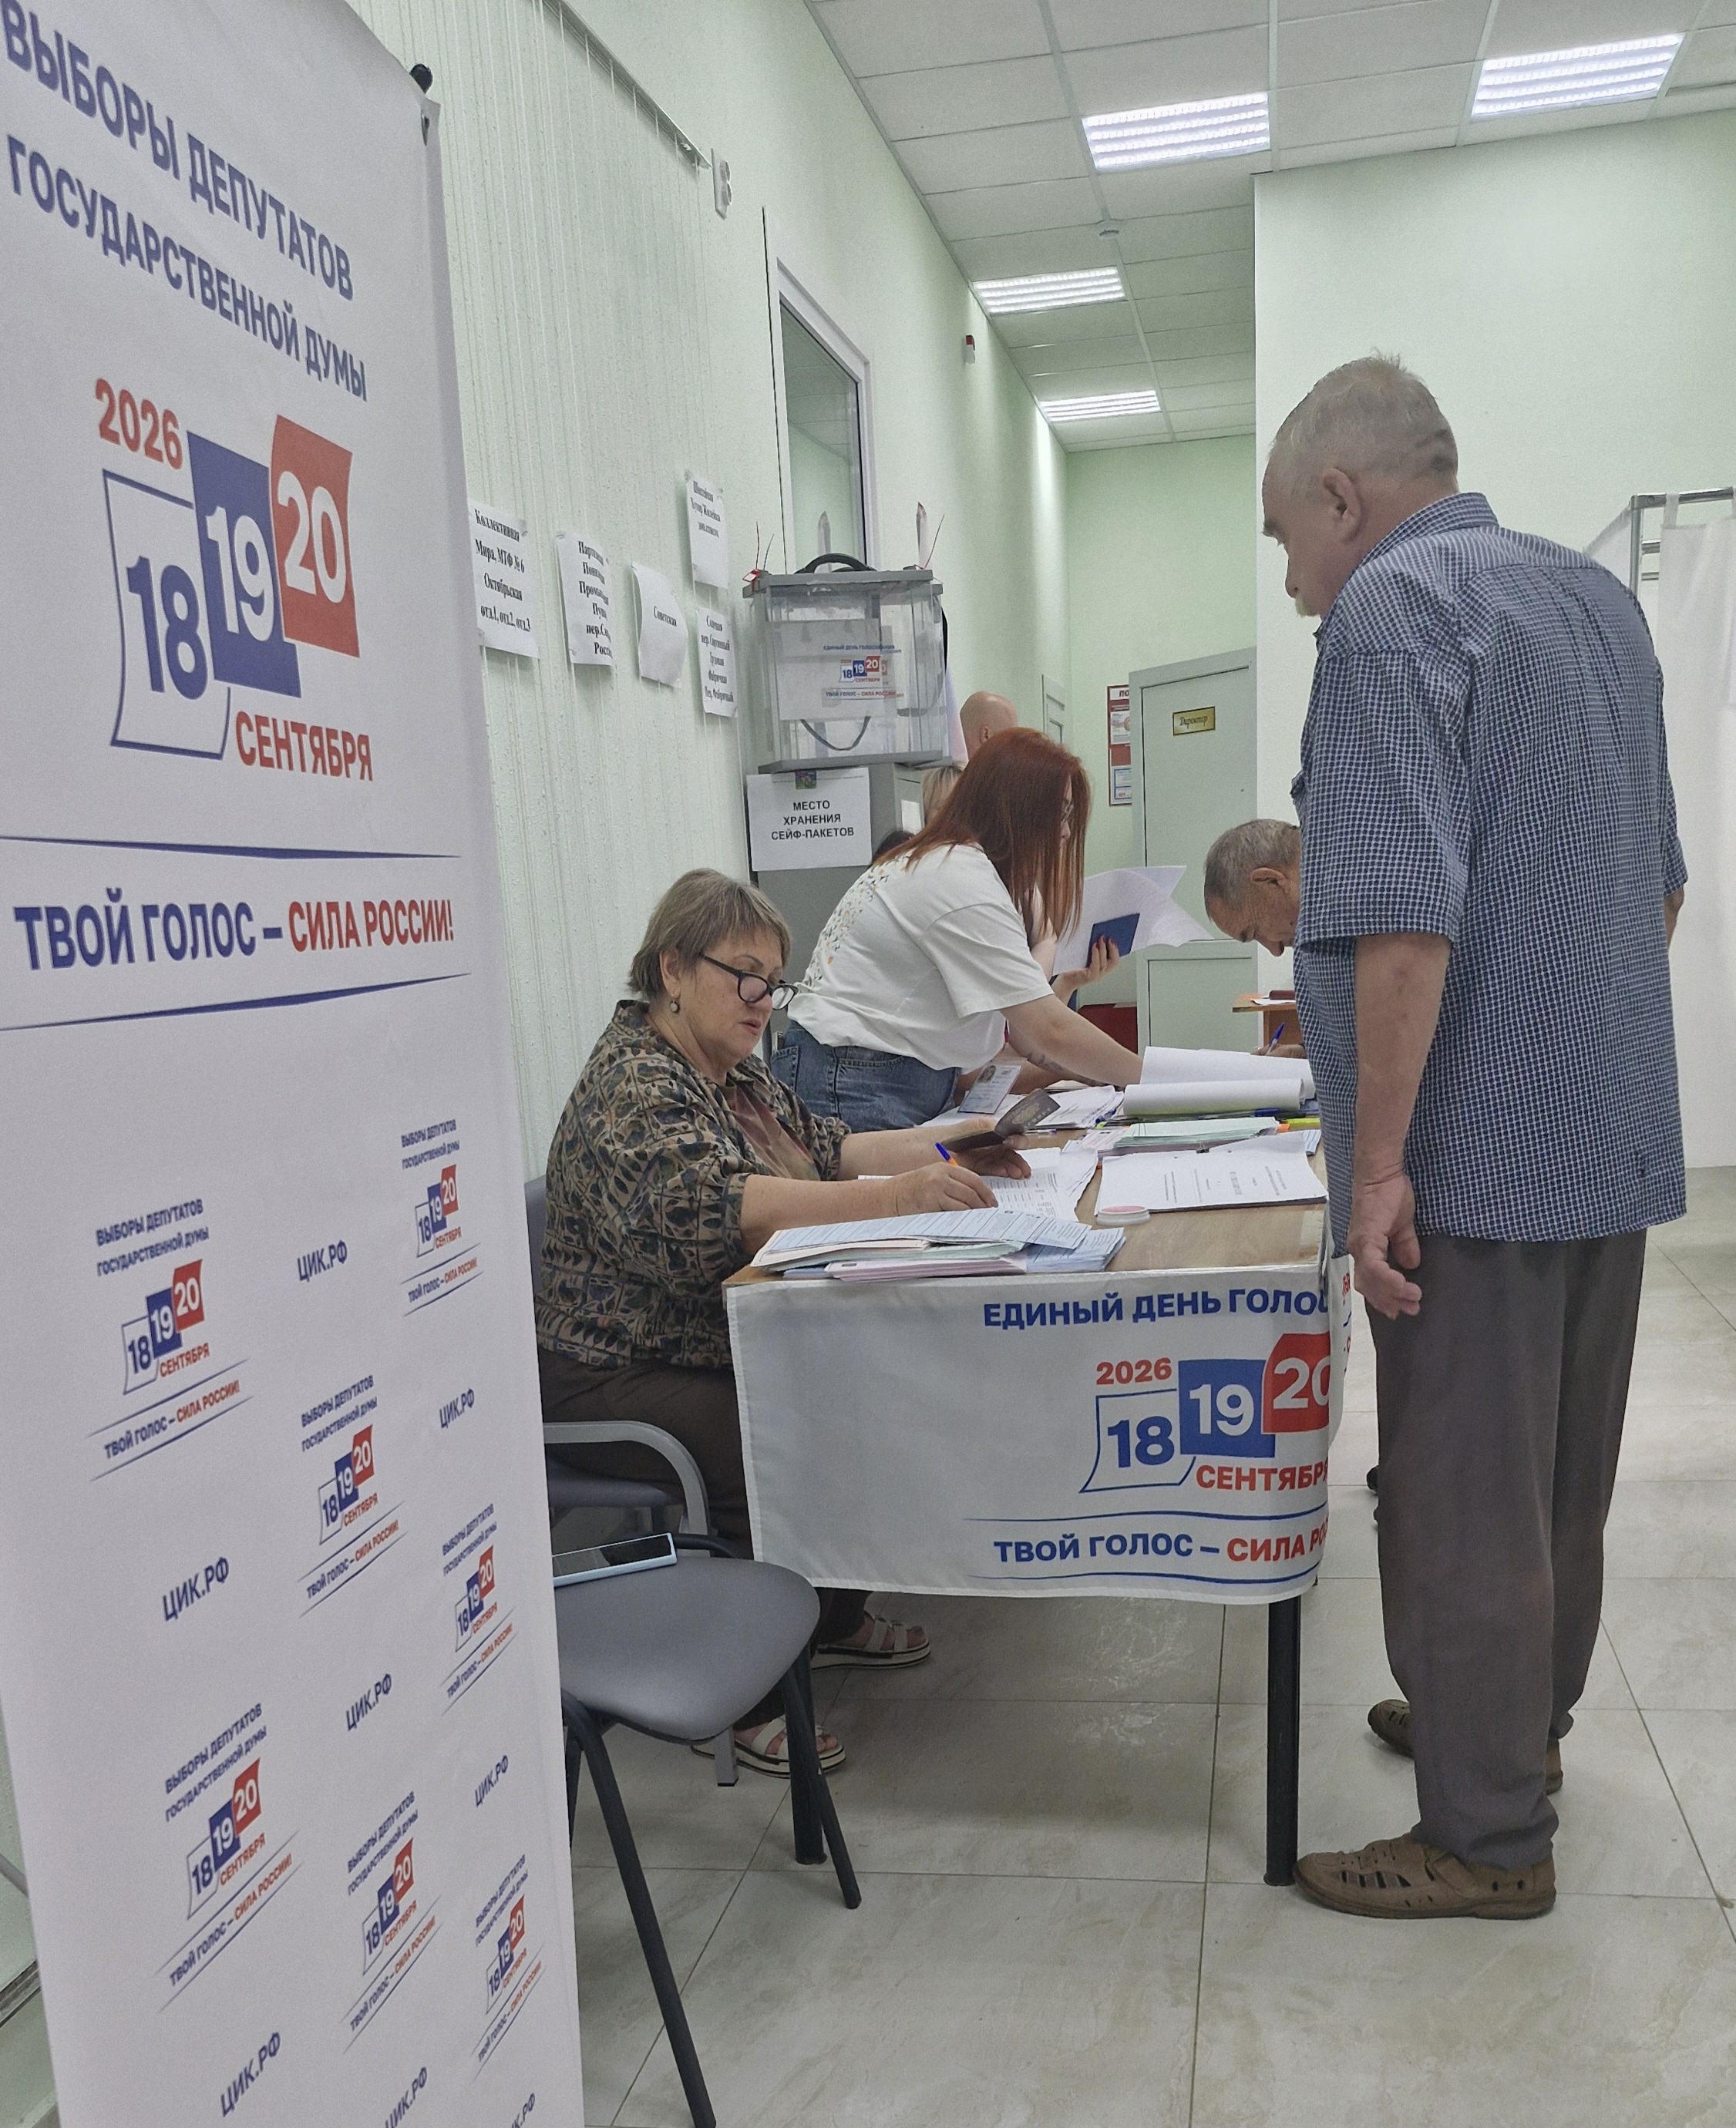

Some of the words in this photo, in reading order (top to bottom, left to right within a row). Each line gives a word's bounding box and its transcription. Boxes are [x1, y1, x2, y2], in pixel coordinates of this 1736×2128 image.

[2, 0, 180, 180] ВЫБОРЫ
[188, 133, 353, 301] ДЕПУТАТОВ
[7, 135, 301, 361] ГОСУДАРСТВЕННОЙ
[305, 325, 368, 402] ДУМЫ
[96, 378, 183, 470] 2026
[475, 509, 520, 542] Коллективная
[475, 539, 496, 563] Мира,
[497, 547, 513, 568] МТФ
[126, 555, 207, 701] 18
[206, 506, 274, 642] 19
[278, 471, 346, 604] 20
[484, 573, 523, 601] Октябрьская
[843, 669, 852, 678] 18
[854, 664, 864, 674] 19
[866, 659, 879, 669] 20
[236, 711, 373, 782] СЕНТЯБРЯ
[772, 827, 854, 840] СЕЙФ-ПАКЕТОВ
[783, 813, 841, 825] ХРАНЕНИЯ
[793, 800, 830, 812] МЕСТО
[14, 887, 135, 970] ТВОЙ
[142, 902, 257, 962] ГОЛОС
[288, 900, 362, 952] СИЛА
[364, 899, 455, 946] РОССИИ!
[96, 1212, 145, 1247] ВЫБОРЫ
[146, 1198, 204, 1234] ДЕПУТАТОВ
[419, 1215, 432, 1244] 18
[430, 1196, 443, 1222] 19
[442, 1177, 456, 1205] 20
[97, 1232, 184, 1276] ГОСУДАРСТВЕННОЙ
[185, 1227, 210, 1249] ДУМЫ
[298, 1239, 347, 1282] ЦИК.РФ
[128, 1335, 151, 1374] 18
[152, 1306, 174, 1344] 19
[174, 1277, 200, 1316] 20
[984, 1293, 1123, 1330] ЕДИНЫЙ
[1132, 1291, 1221, 1322] ДЕНЬ
[160, 1343, 210, 1377] СЕНТЯБРЯ
[1096, 1357, 1172, 1385] 2026
[301, 1397, 333, 1427] ВЫБОРЫ
[335, 1375, 374, 1410] ДЕПУТАТОВ
[301, 1405, 360, 1452] ГОСУДАРСТВЕННОЙ
[361, 1397, 377, 1417] ДУМЫ
[439, 1388, 475, 1429] ЦИК.РФ
[1107, 1415, 1175, 1468] 18
[1189, 1384, 1254, 1436] 19
[1272, 1356, 1330, 1410] 20
[104, 1430, 133, 1459] ТВОЙ
[135, 1417, 167, 1444] ГОЛОС
[177, 1400, 202, 1423] СИЛА
[322, 1494, 338, 1527] 18
[338, 1467, 354, 1498] 19
[354, 1441, 372, 1474] 20
[344, 1492, 378, 1527] СЕНТЯБРЯ
[307, 1574, 326, 1599] ТВОЙ
[325, 1558, 349, 1586] ГОЛОС
[355, 1544, 372, 1562] СИЛА
[994, 1533, 1081, 1563] ТВОЙ
[1089, 1532, 1193, 1557] ГОЛОС
[1226, 1534, 1305, 1562] СИЛА
[163, 1557, 230, 1622] ЦИК.РФ
[458, 1608, 469, 1636] 18
[469, 1586, 480, 1612] 19
[479, 1559, 493, 1588] 20
[346, 1673, 392, 1731] ЦИК.РФ
[166, 1747, 209, 1794] ВЫБОРЫ
[210, 1703, 262, 1759] ДЕПУТАТОВ
[166, 1743, 244, 1822] ГОСУДАРСТВЕННОЙ
[245, 1726, 267, 1756] ДУМЫ
[475, 1754, 509, 1807] ЦИК.РФ
[193, 1855, 214, 1895] 18
[213, 1817, 234, 1857] 19
[234, 1779, 257, 1821] 20
[220, 1832, 266, 1886] СЕНТЯБРЯ
[366, 1921, 381, 1955] 18
[381, 1889, 395, 1921] 19
[395, 1855, 411, 1892] 20
[170, 1950, 196, 1986] ТВОЙ
[197, 1922, 227, 1960] ГОЛОС
[234, 1891, 257, 1920] СИЛА
[489, 1968, 500, 1996] 18
[500, 1940, 510, 1968] 19
[510, 1910, 523, 1941] 20
[220, 2032, 281, 2117] ЦИК.РФ
